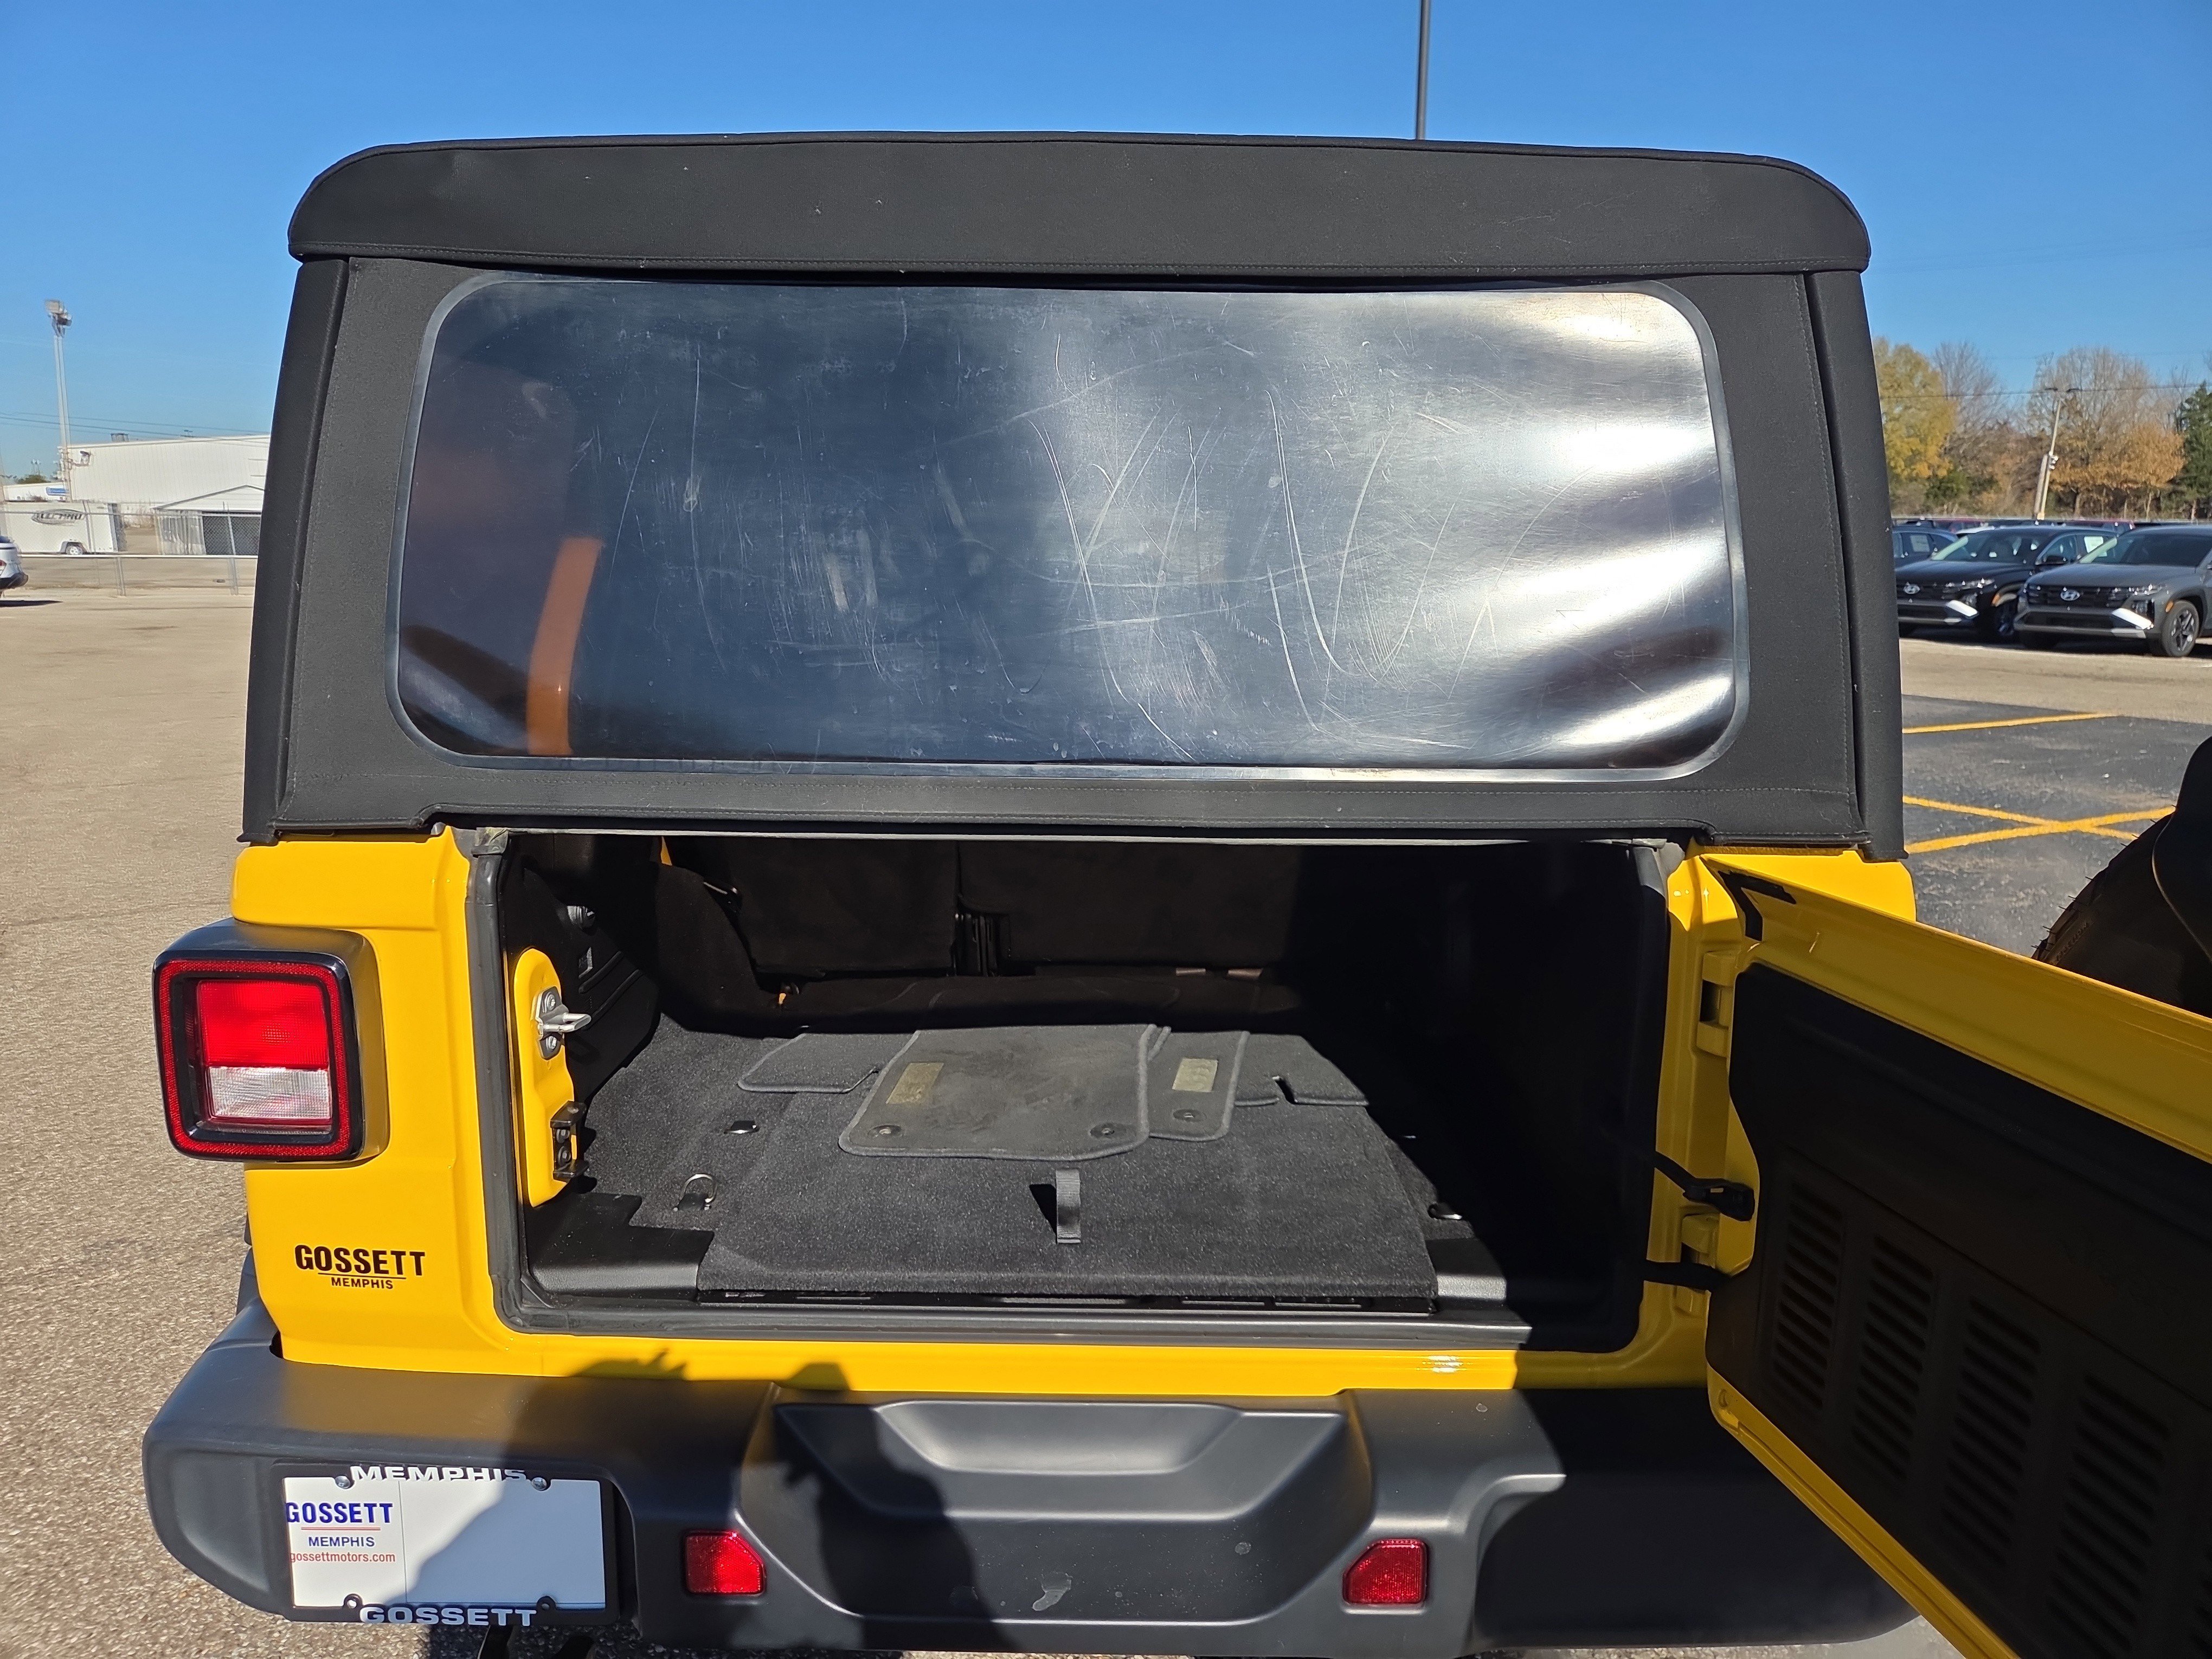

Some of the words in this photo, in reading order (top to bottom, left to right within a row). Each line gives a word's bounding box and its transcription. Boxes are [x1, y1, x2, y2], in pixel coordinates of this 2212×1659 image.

[294, 1244, 426, 1276] GOSSETT
[331, 1277, 394, 1289] MEMPHIS
[350, 1465, 526, 1481] MEMPHIS
[286, 1502, 394, 1523] GOSSETT
[308, 1536, 375, 1547] MEMPHIS
[290, 1552, 396, 1562] gossettmotors.com
[359, 1606, 537, 1626] GOSSETT
